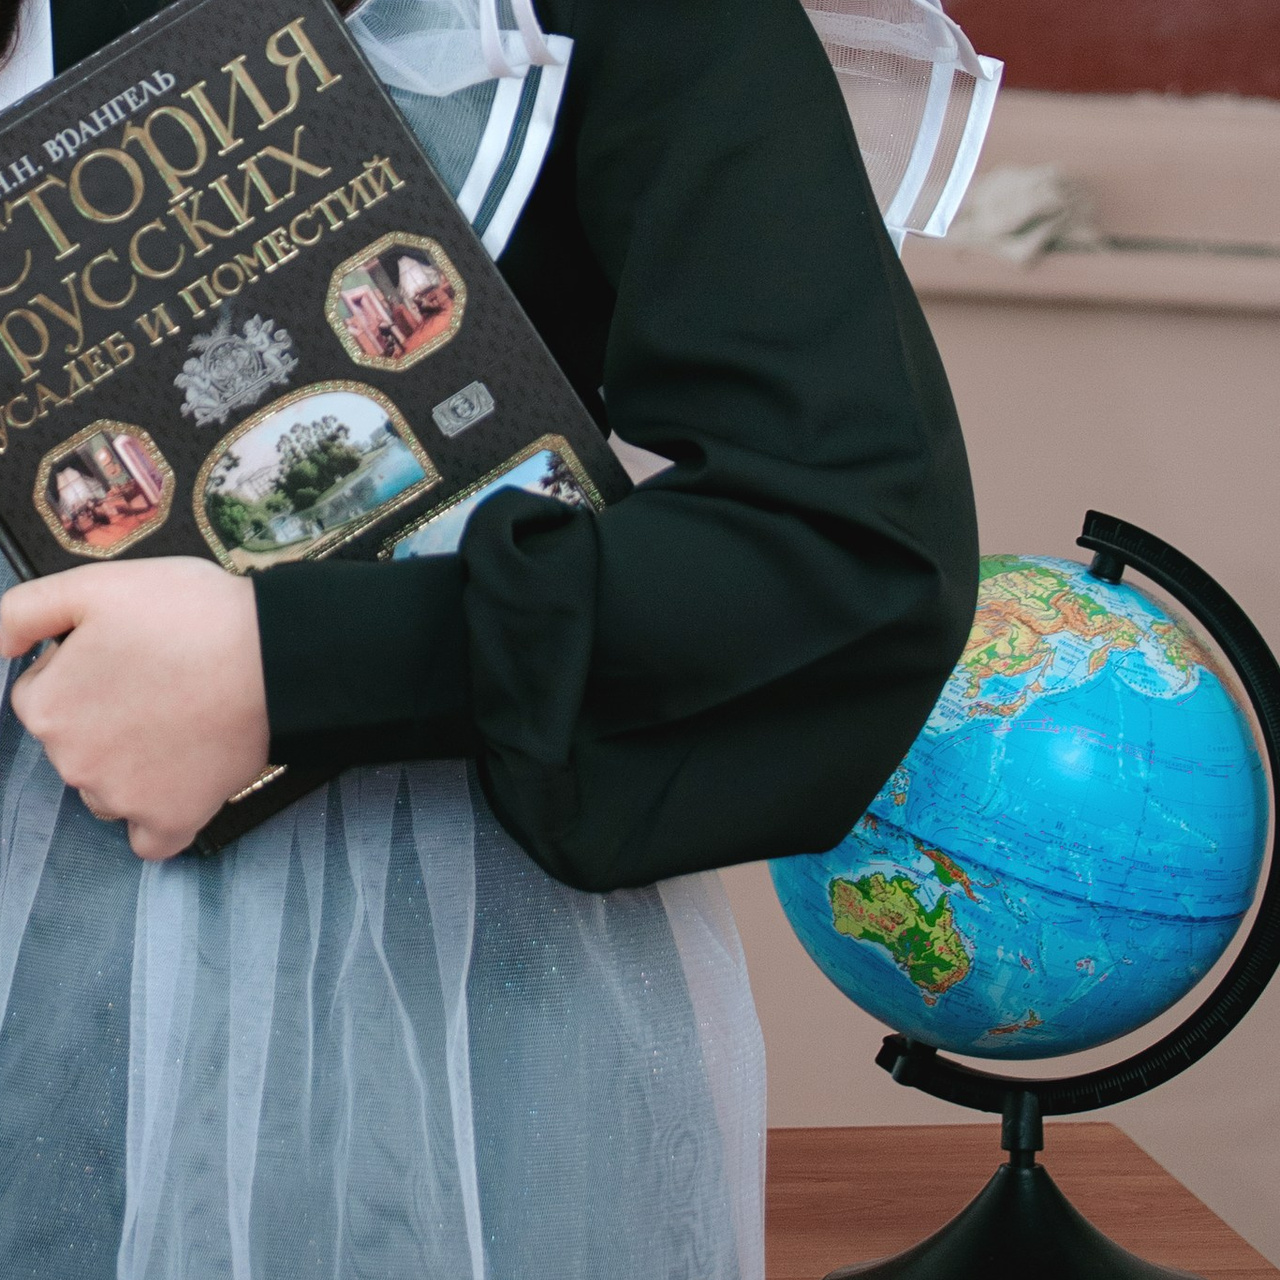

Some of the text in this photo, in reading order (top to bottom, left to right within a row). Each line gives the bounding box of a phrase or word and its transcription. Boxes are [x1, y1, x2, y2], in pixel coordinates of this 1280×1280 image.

[42, 69, 176, 165] ВРАНГЕЛЬ
[135, 302, 180, 347] И
[177, 154, 406, 319] ПОМЕСТИЙ
